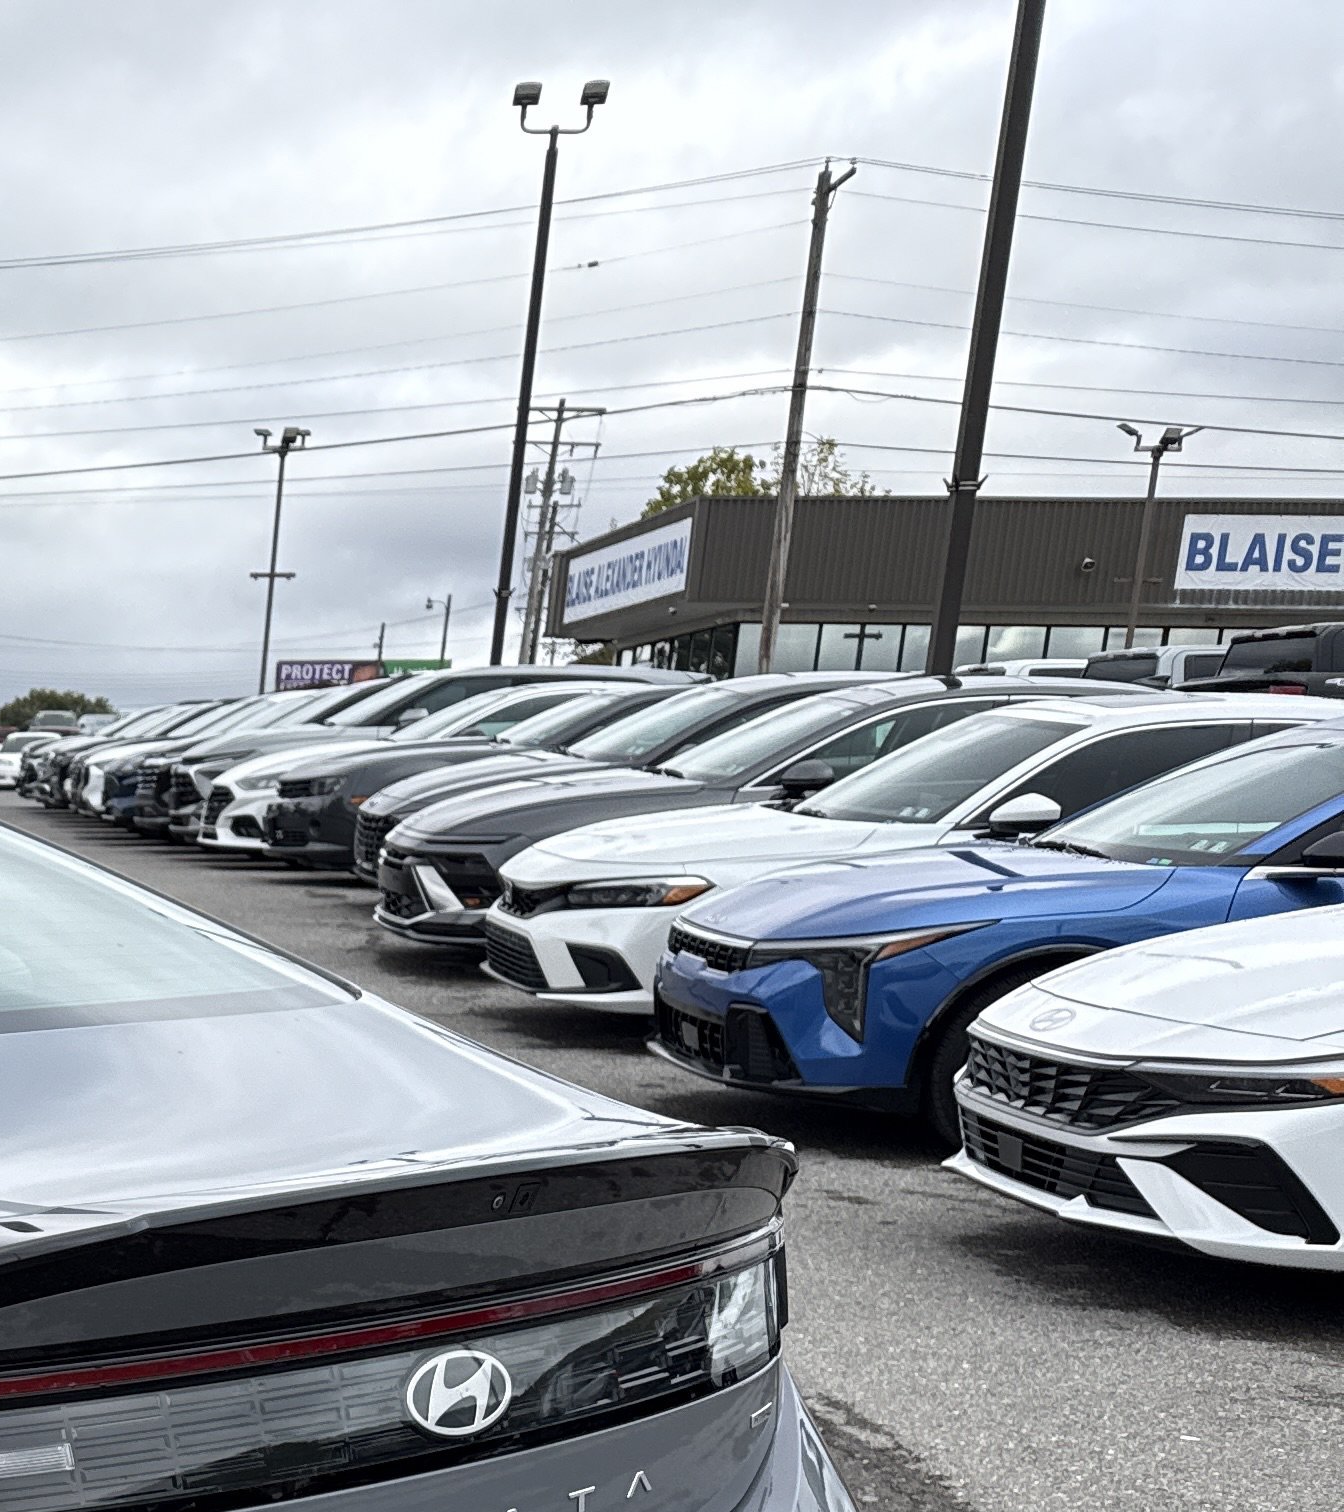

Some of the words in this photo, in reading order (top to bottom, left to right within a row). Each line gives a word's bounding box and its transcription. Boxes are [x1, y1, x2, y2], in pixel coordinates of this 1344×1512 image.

[566, 566, 596, 608] BLAISE
[593, 550, 645, 600] ALEXANDER
[644, 535, 688, 585] HYUNDAI
[1185, 532, 1344, 574] BLAISE
[280, 663, 353, 681] PROTECT
